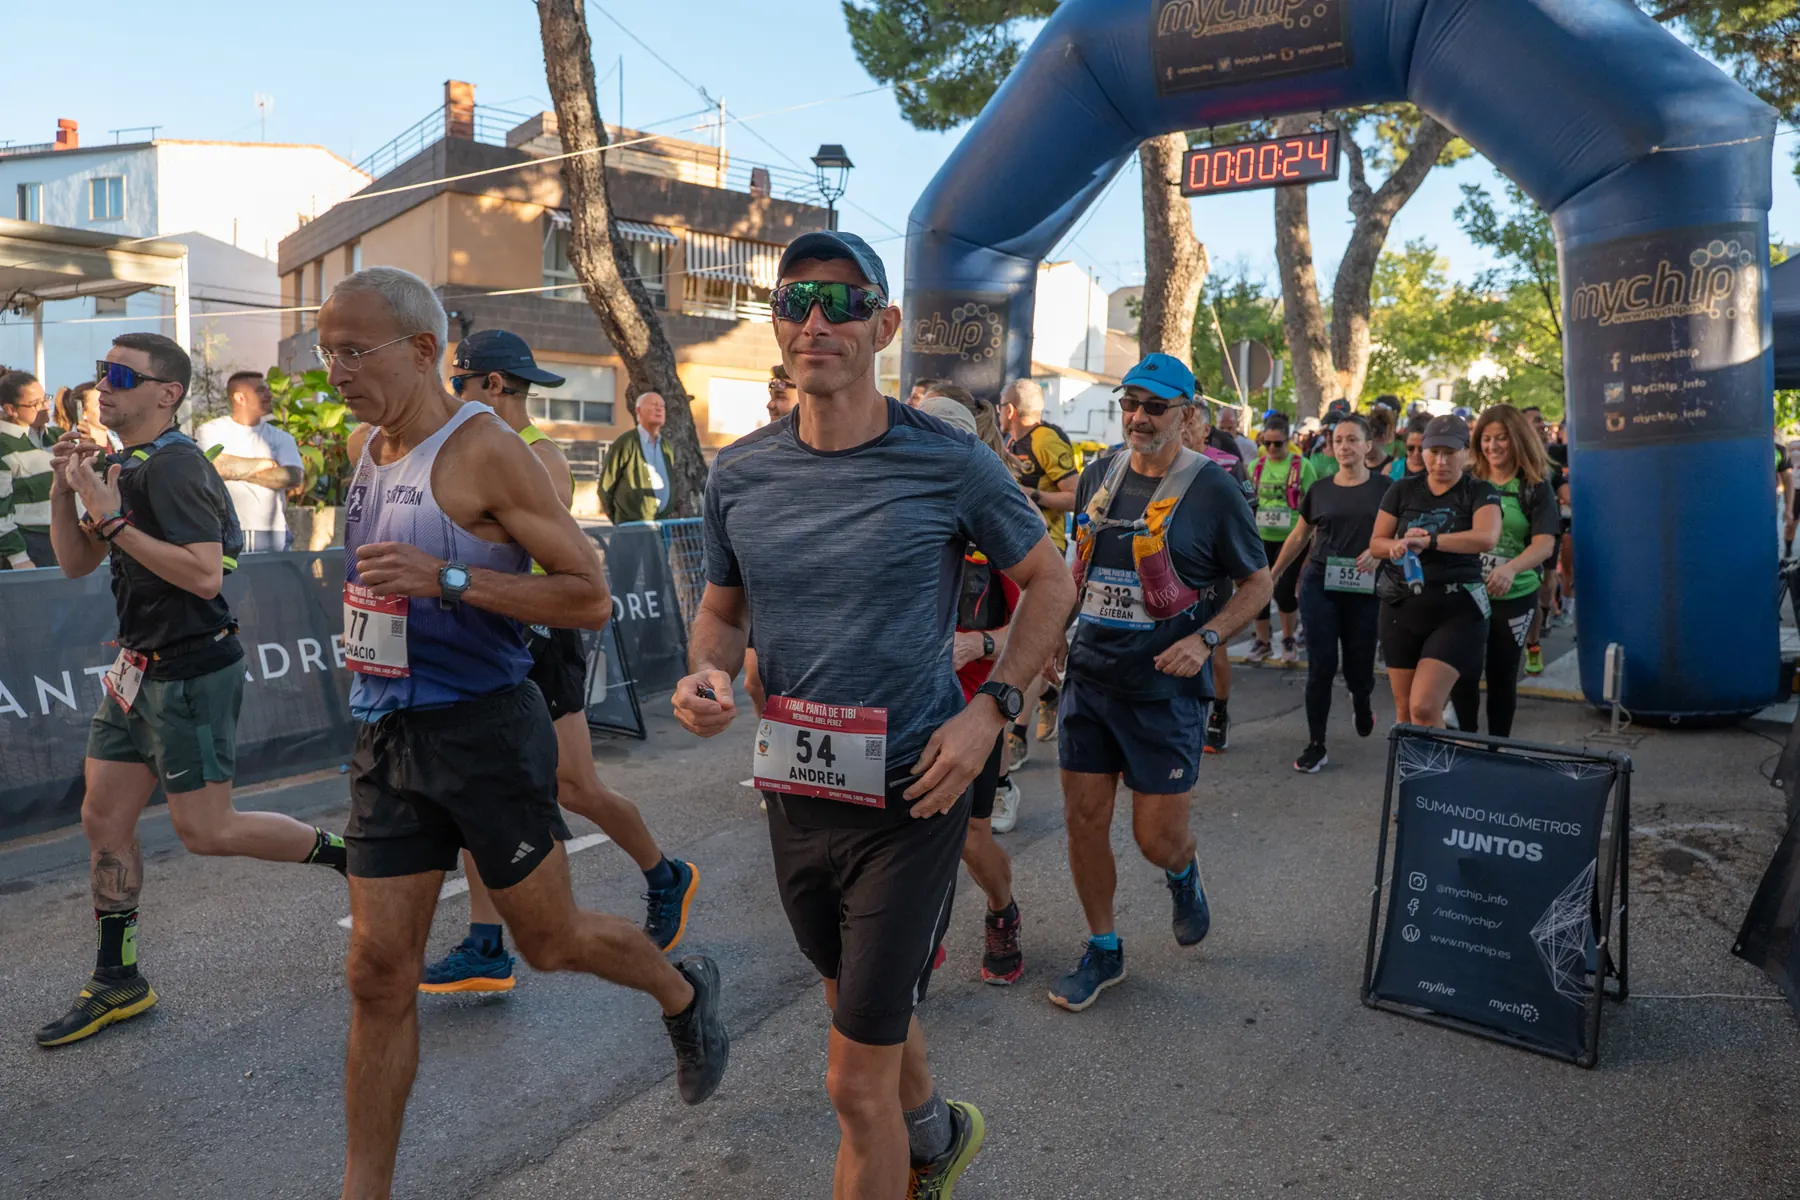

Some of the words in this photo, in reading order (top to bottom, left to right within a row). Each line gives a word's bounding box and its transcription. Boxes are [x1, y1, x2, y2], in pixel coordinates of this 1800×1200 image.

[1190, 140, 1328, 189] 00:00:24
[1571, 256, 1737, 327] mychip
[1630, 347, 1700, 364] infomychip
[1339, 567, 1362, 580] 552
[1480, 555, 1496, 570] 04
[1100, 607, 1134, 620] ESTEBAN
[350, 610, 369, 642] 77
[244, 633, 347, 682] DRE
[346, 642, 376, 661] GNACIO
[788, 700, 805, 713] TRAIL
[805, 702, 828, 717] PANTÀ
[828, 707, 840, 718] DE
[840, 708, 857, 719] TIBI
[796, 730, 836, 768] 54
[789, 766, 846, 787] ANDREW
[1168, 768, 1184, 780] NB
[1416, 796, 1485, 822] SUMANDO
[1488, 811, 1582, 837] KILÓMETROS
[1443, 828, 1543, 862] JUNTOS
[1436, 882, 1508, 907] @mychip_info
[1432, 906, 1503, 930] /infomychip/
[1430, 933, 1511, 961] www.mychip.es
[1418, 979, 1456, 996] mylive
[1488, 998, 1532, 1020] mychip
